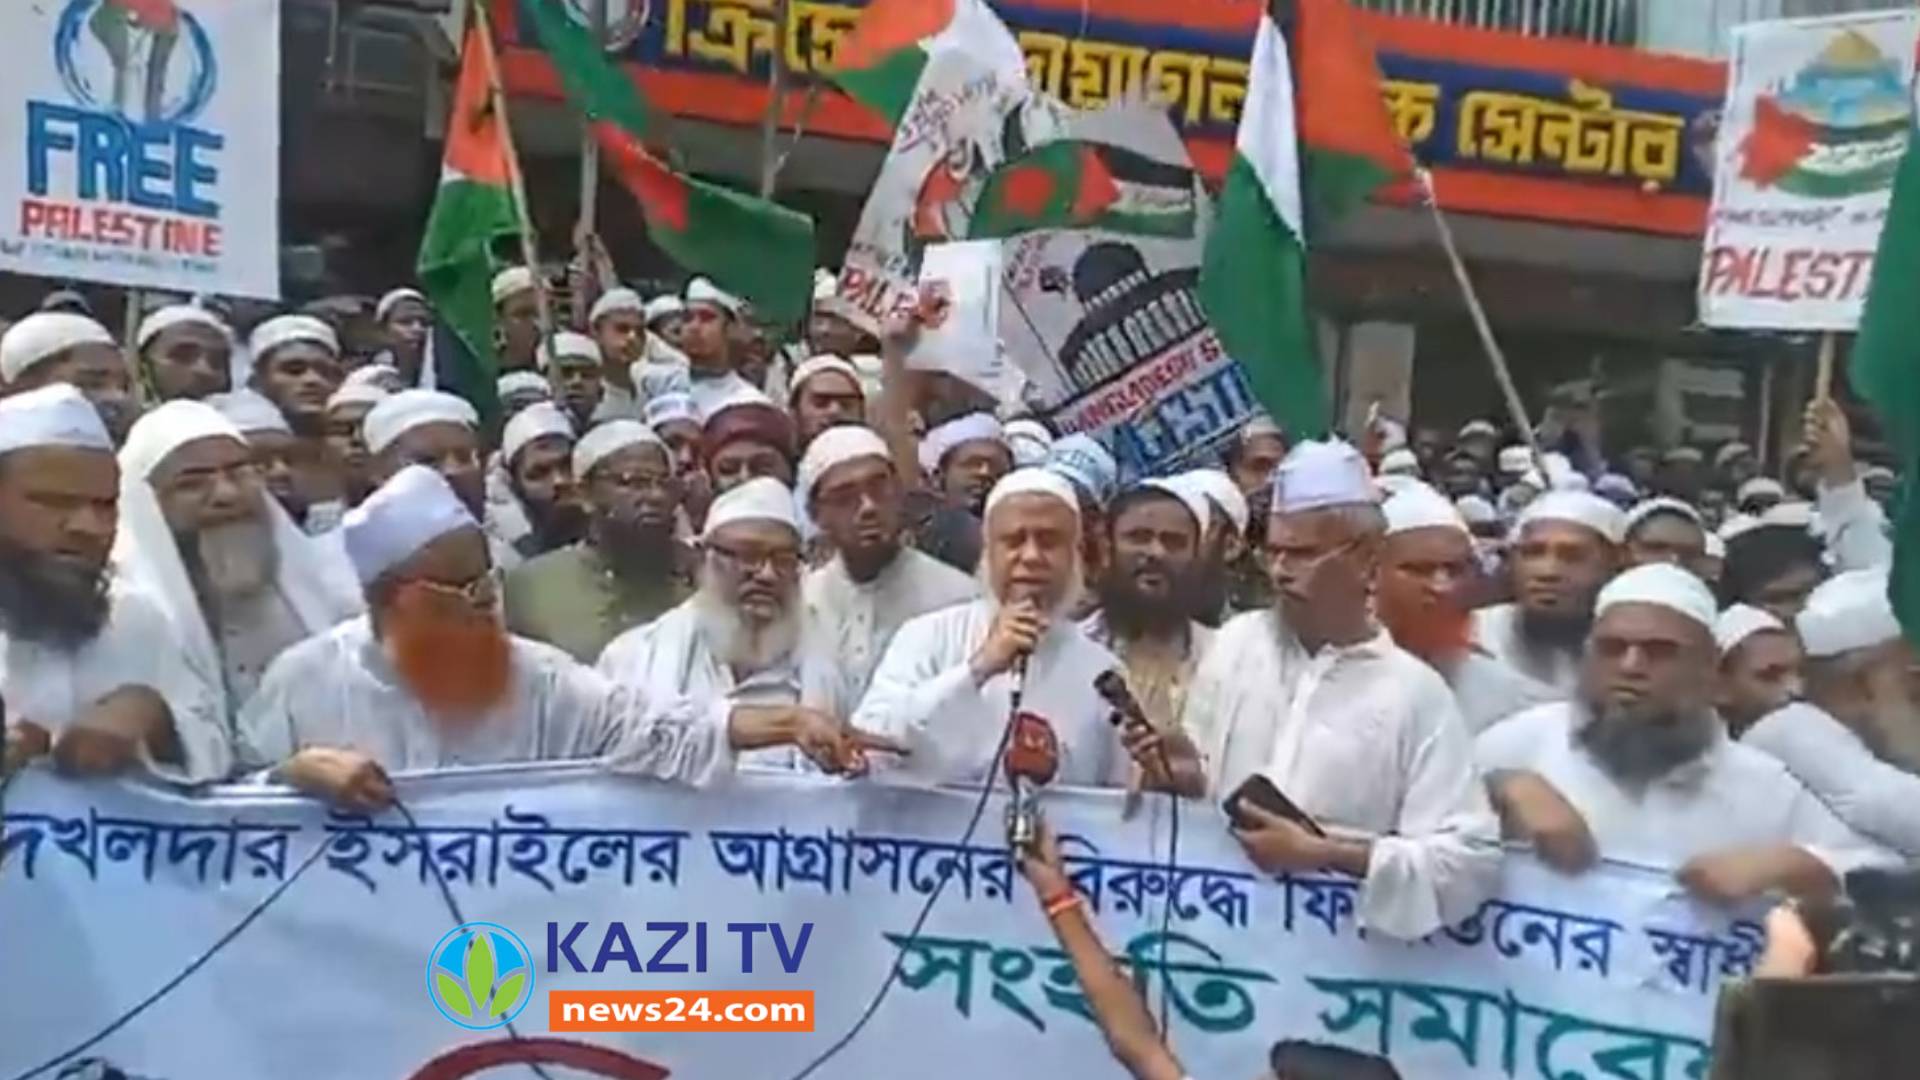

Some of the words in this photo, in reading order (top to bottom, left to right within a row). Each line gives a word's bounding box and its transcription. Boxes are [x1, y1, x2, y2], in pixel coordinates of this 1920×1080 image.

[26, 99, 223, 219] FREE
[1458, 79, 1685, 191] সেন্টার
[22, 200, 222, 256] PALESTINE
[1702, 247, 1873, 302] PALEST
[324, 806, 691, 891] ইসরাইলের
[709, 828, 1014, 904] আগ্রাসনের
[1306, 975, 1714, 1080] সমাবে
